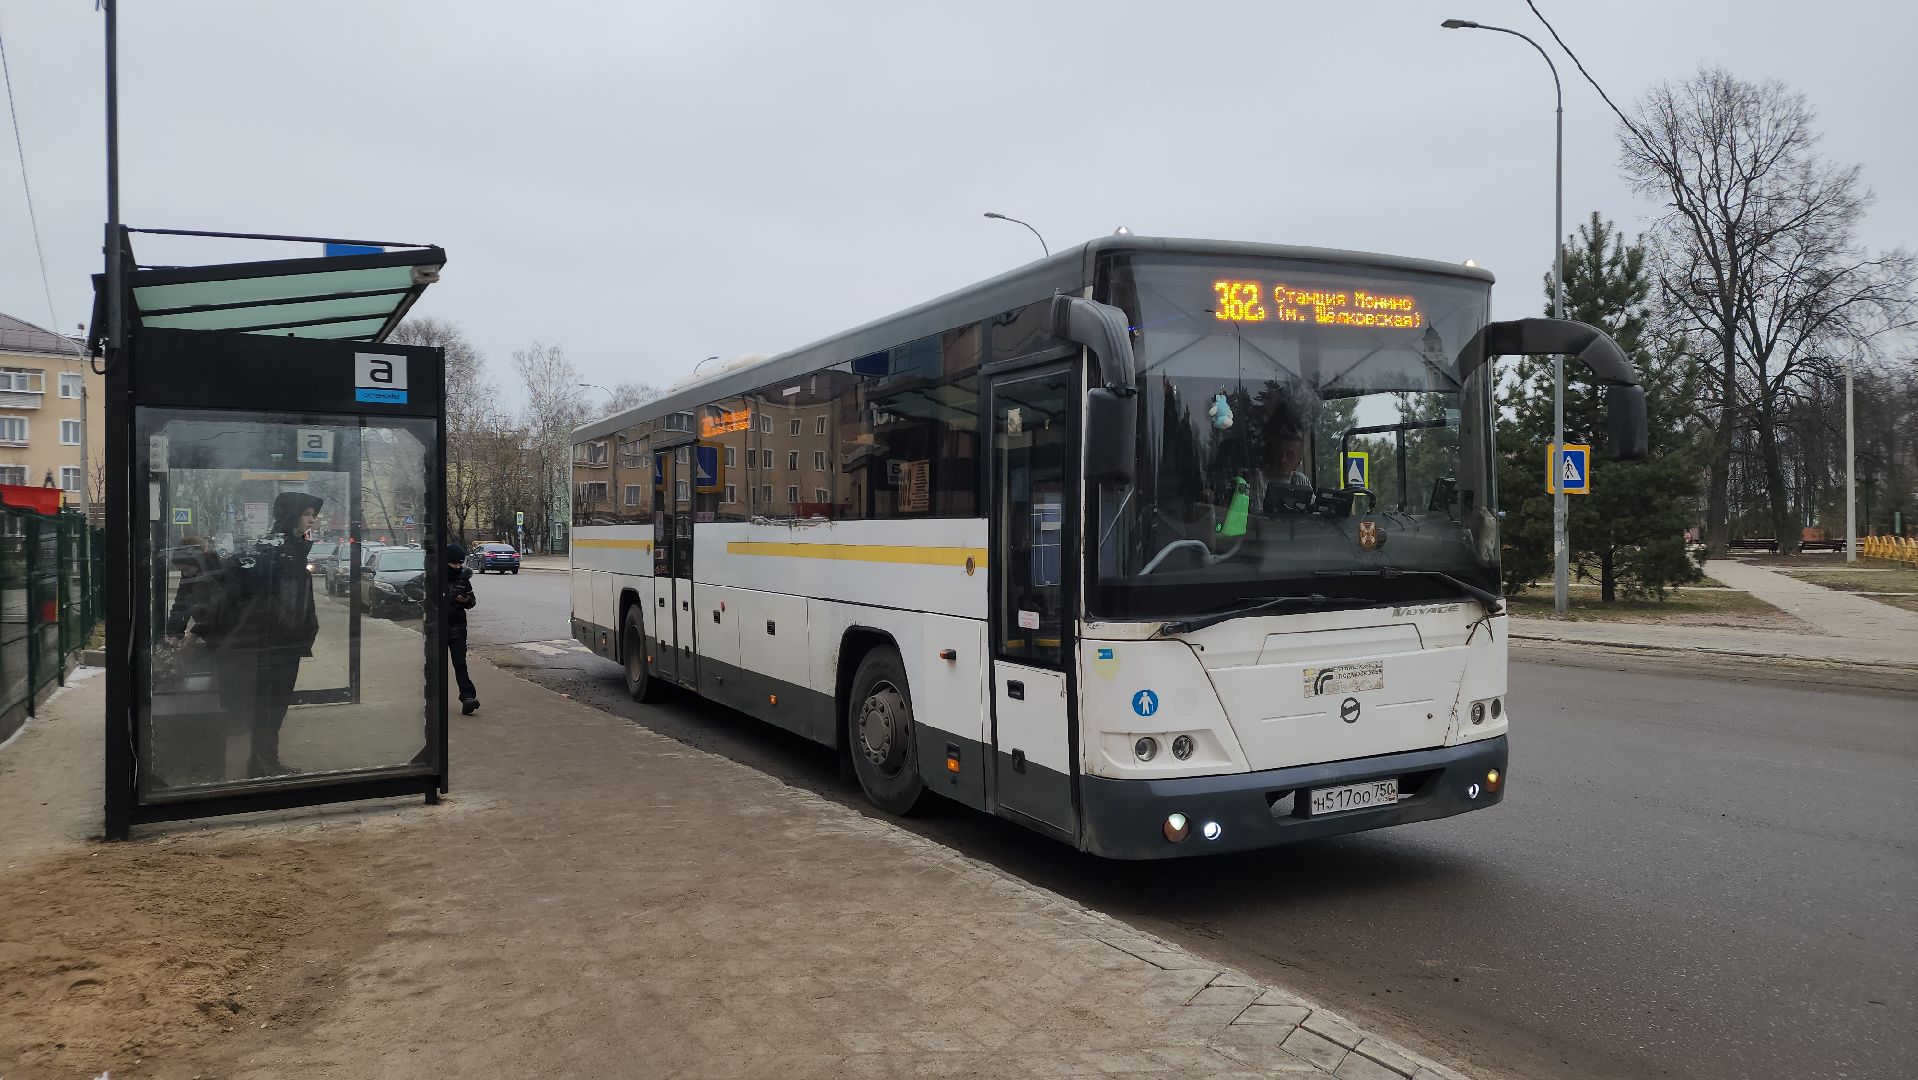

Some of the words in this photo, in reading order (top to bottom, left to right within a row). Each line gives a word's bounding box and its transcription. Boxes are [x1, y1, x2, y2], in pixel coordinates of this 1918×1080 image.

[1274, 286, 1346, 306] Станция
[1354, 291, 1413, 311] Монино
[1374, 783, 1393, 798] 750
